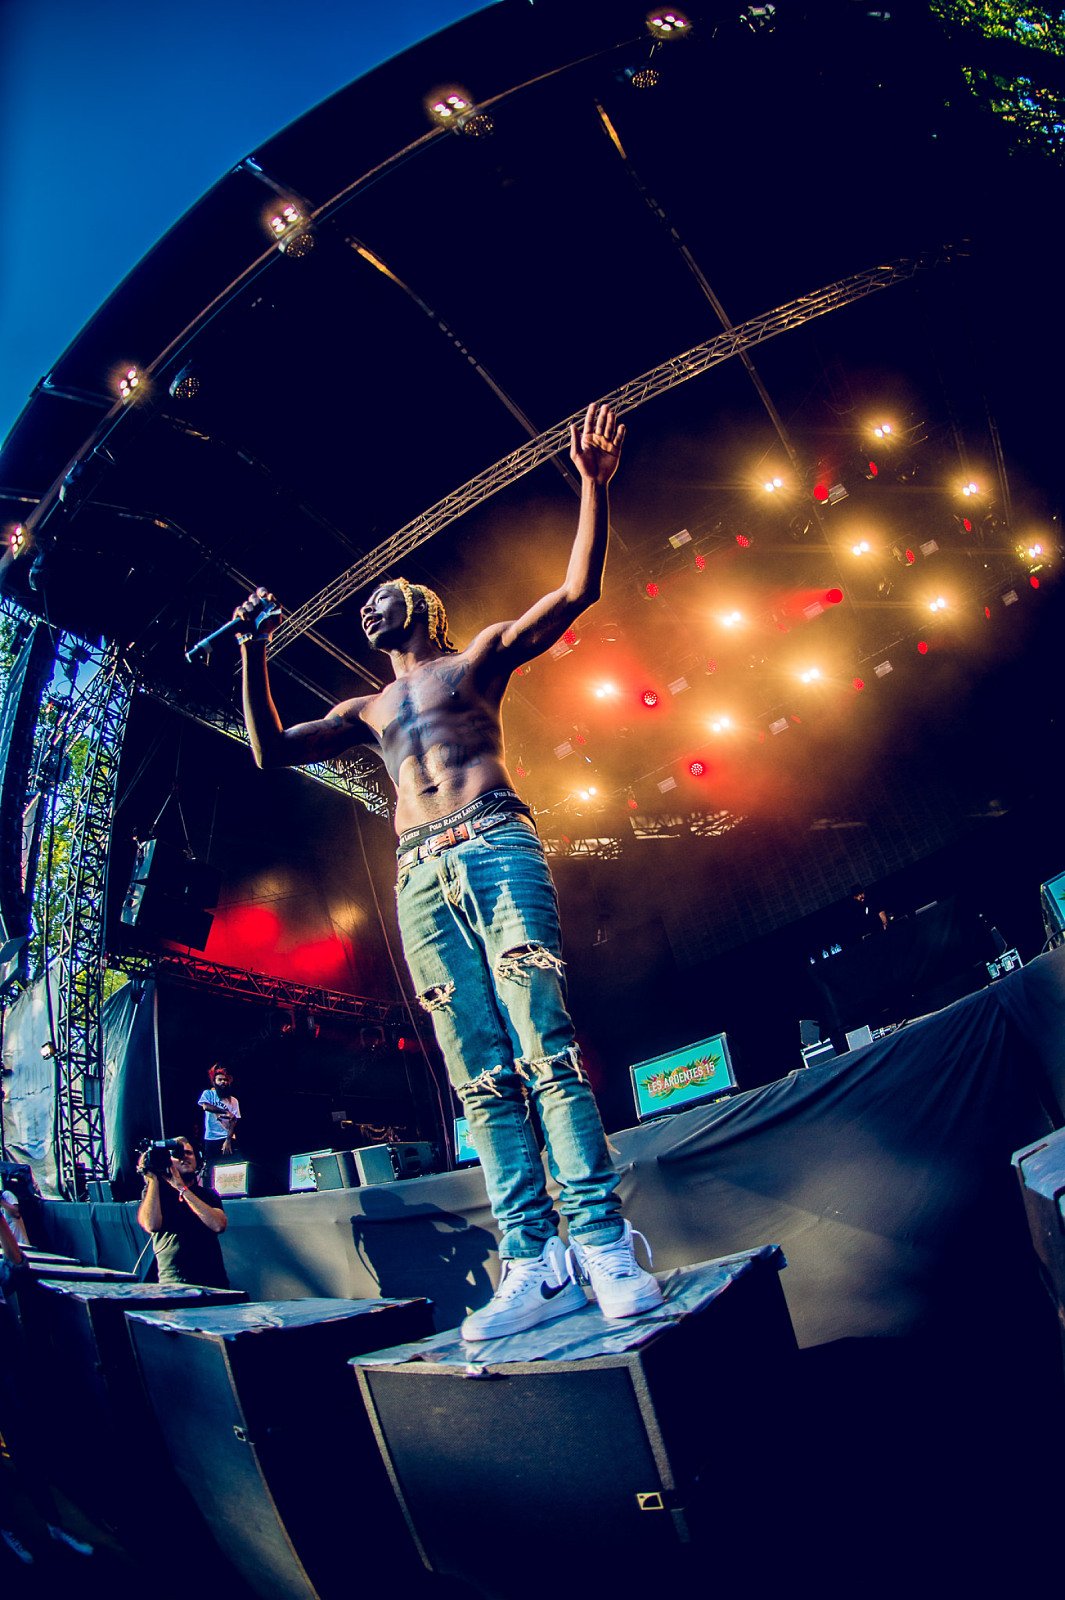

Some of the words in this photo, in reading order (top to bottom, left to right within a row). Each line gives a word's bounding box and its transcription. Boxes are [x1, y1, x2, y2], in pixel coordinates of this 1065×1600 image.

[443, 813, 462, 826] RALPH
[462, 801, 484, 814] LAUREN
[647, 1080, 662, 1093] LES
[664, 1065, 703, 1088] ARDENTES
[705, 1061, 715, 1074] 15
